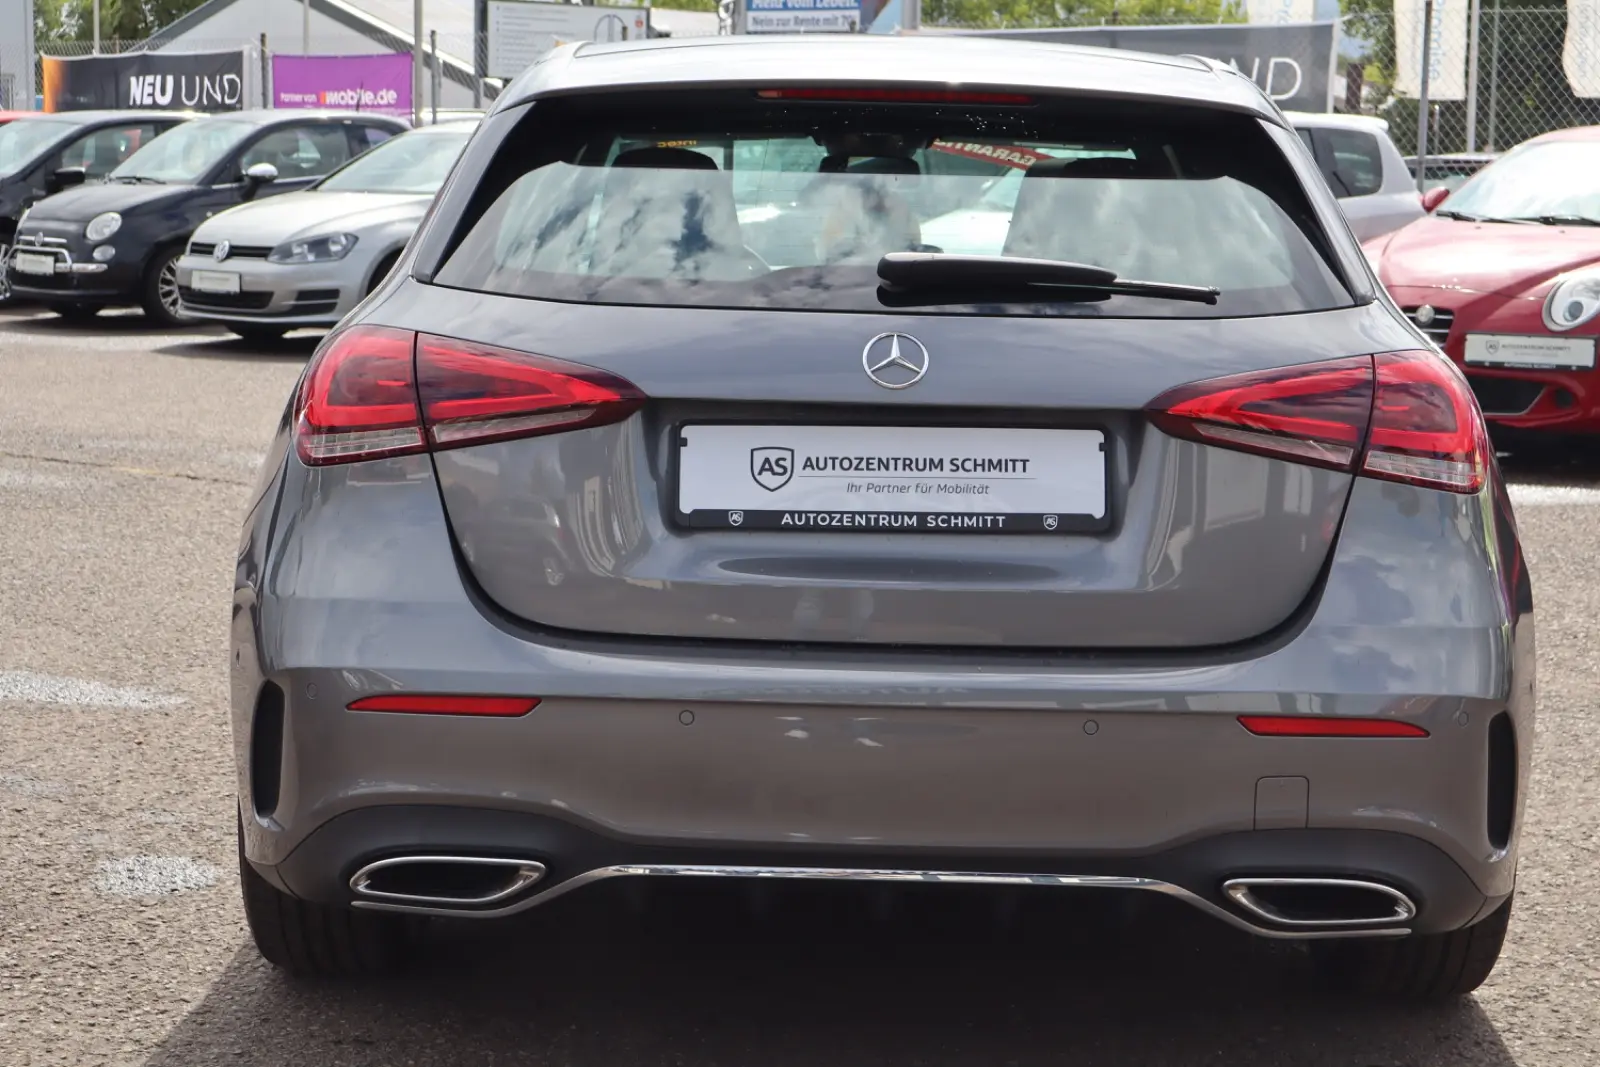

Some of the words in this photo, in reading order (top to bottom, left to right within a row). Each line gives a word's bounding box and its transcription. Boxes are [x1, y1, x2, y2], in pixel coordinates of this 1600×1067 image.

[129, 74, 174, 106] NEU
[181, 73, 241, 106] UND
[757, 457, 788, 476] AS
[802, 456, 944, 472] AUTOZENTRUM
[949, 457, 1030, 474] SCHMITT
[846, 482, 862, 493] Ihr
[866, 483, 911, 494] Partner
[915, 483, 933, 495] für
[936, 483, 990, 495] Mobilität
[781, 513, 918, 527] AUTOZENTRUM
[926, 515, 1006, 528] SCHMITT
